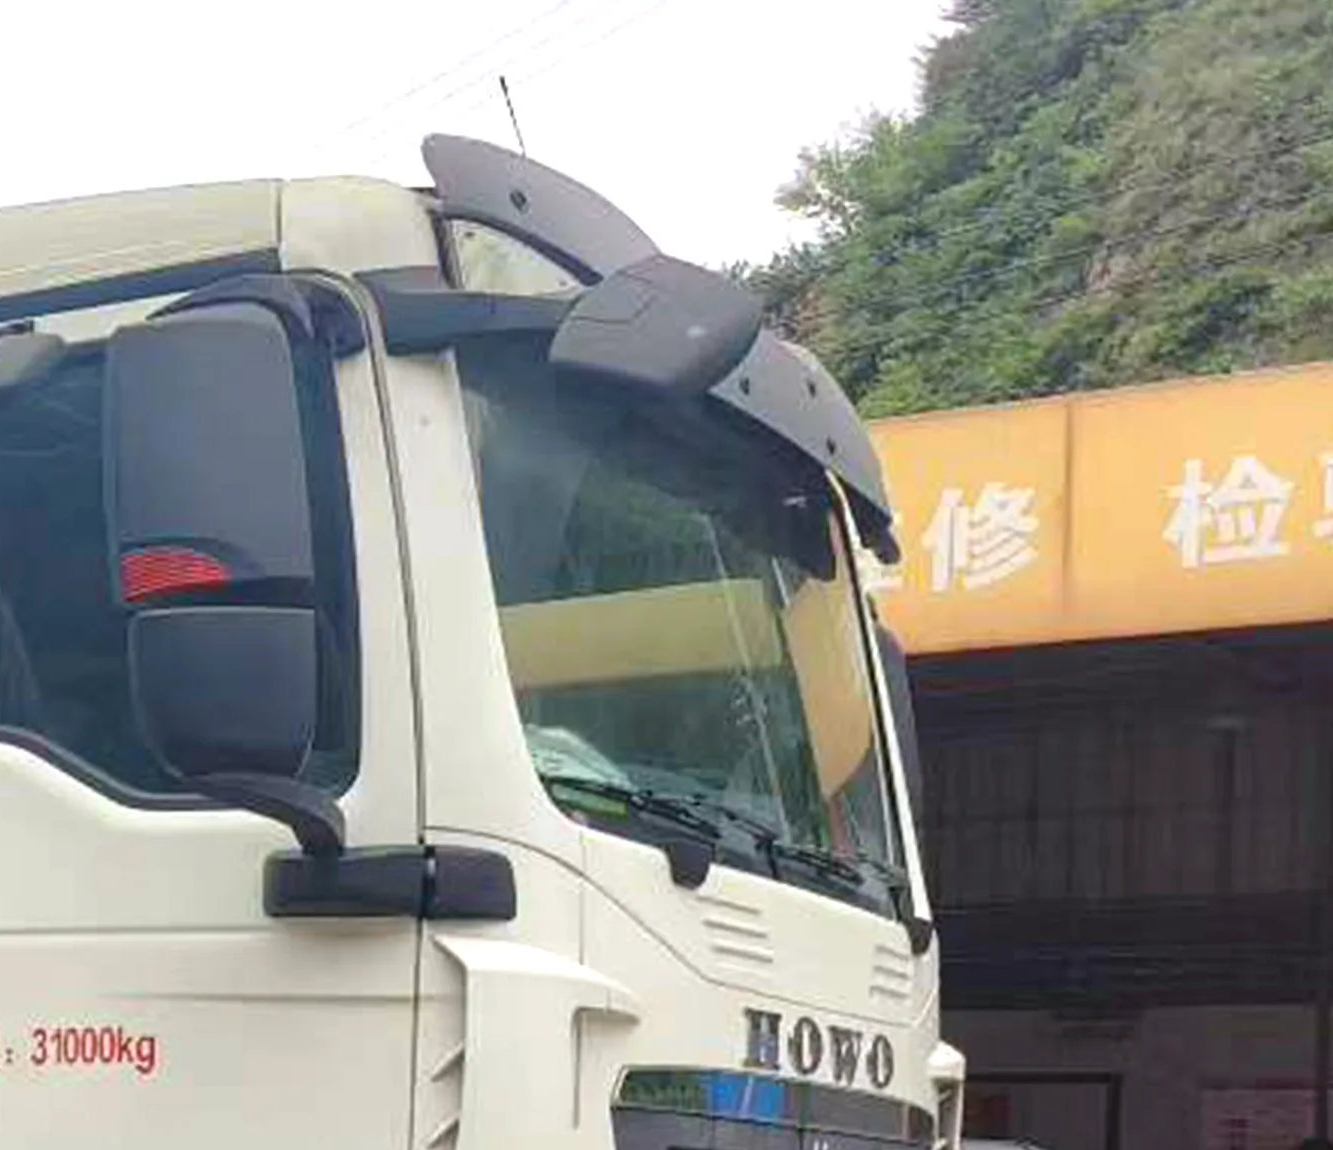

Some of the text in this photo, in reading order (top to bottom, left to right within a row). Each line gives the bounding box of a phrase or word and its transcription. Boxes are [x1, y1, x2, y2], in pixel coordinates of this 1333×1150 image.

[871, 455, 1333, 591] 修 检
[744, 1007, 894, 1090] HOWO
